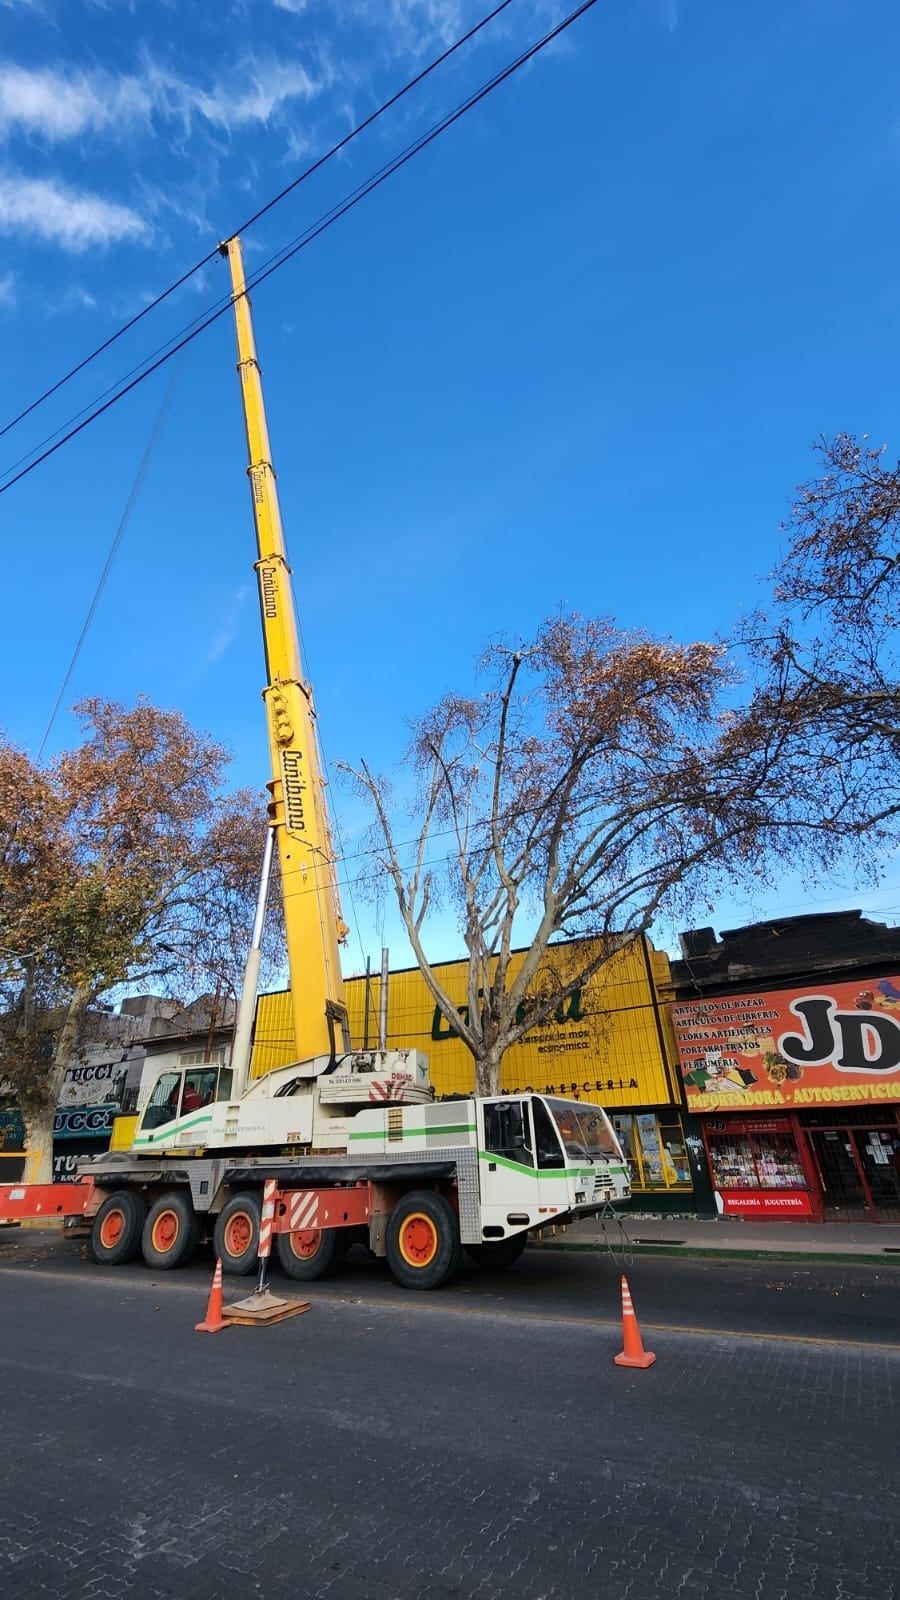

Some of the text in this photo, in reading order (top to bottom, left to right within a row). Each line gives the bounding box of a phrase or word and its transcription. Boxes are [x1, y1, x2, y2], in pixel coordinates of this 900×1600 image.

[282, 750, 306, 831] Cañibano
[720, 1001, 733, 1010] DE
[734, 998, 765, 1008] BAZAR
[723, 1014, 736, 1023] DE
[678, 1025, 772, 1042] FLORES ARTIFICIALES
[779, 996, 900, 1073] JD
[680, 1041, 761, 1055] PORTARRETRATOS
[687, 1082, 900, 1108] IMPORTADORA AUTOSERVICIO
[52, 1109, 115, 1132] UCCI
